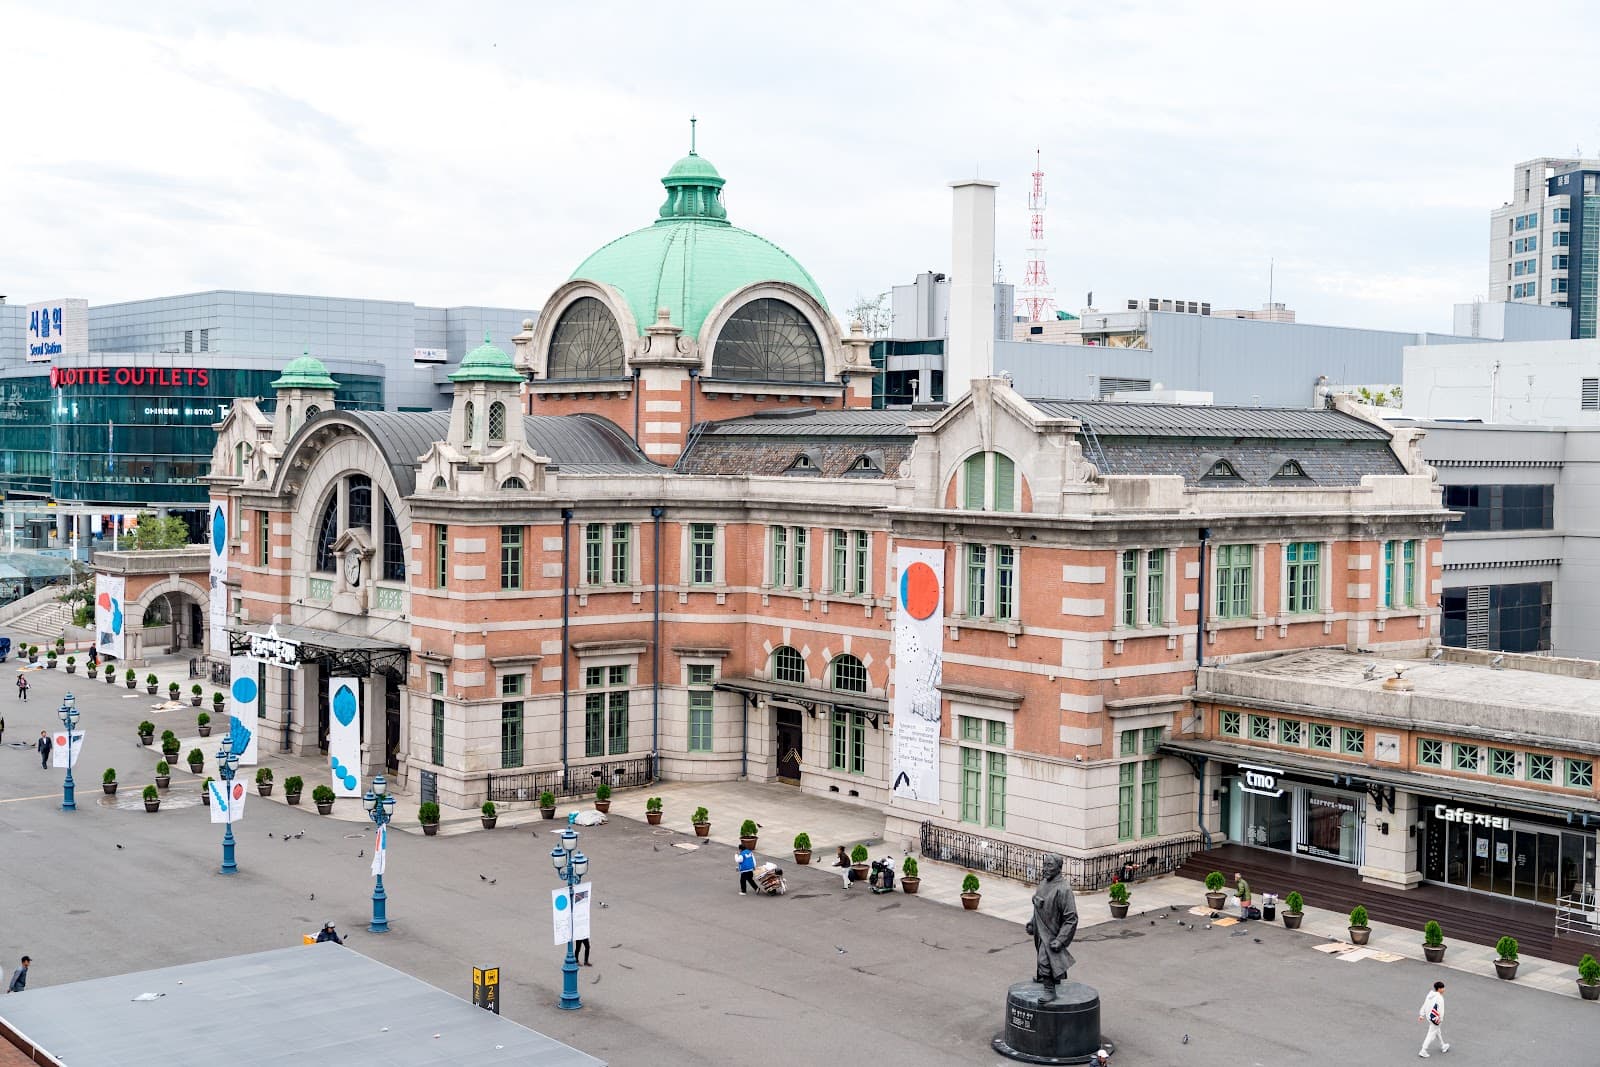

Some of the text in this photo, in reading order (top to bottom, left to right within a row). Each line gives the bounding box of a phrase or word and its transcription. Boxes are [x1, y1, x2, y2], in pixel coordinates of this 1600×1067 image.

[29, 307, 62, 338] 서울역
[30, 341, 62, 356] Seoul Station
[59, 367, 209, 387] LOTTE OUTLETS
[144, 407, 179, 415] CHINESE
[184, 408, 214, 416] BISTRO
[1246, 770, 1275, 789] tmo
[488, 985, 494, 995] 2
